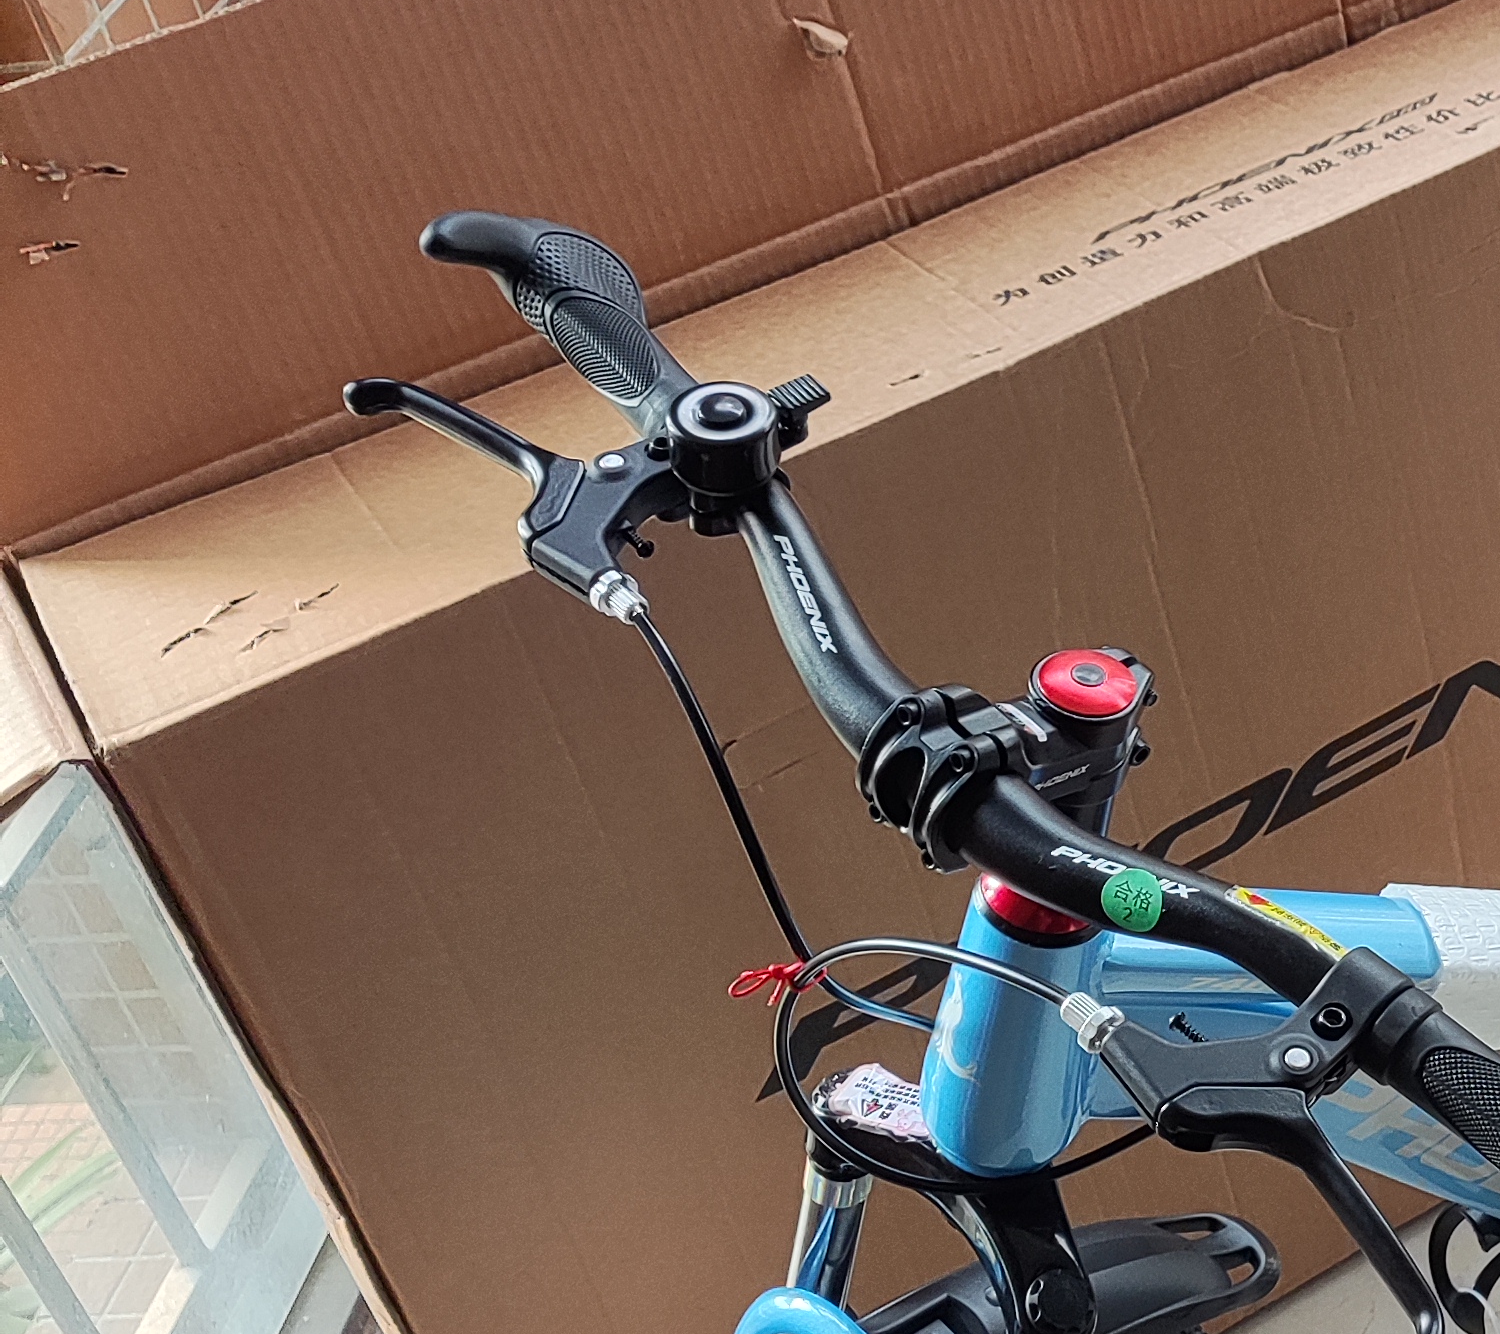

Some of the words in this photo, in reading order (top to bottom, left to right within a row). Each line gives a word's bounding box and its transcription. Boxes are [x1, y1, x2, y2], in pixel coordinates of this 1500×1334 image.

[773, 534, 838, 654] PHOENIX
[1113, 879, 1154, 913] 合格
[1122, 907, 1134, 923] 2
